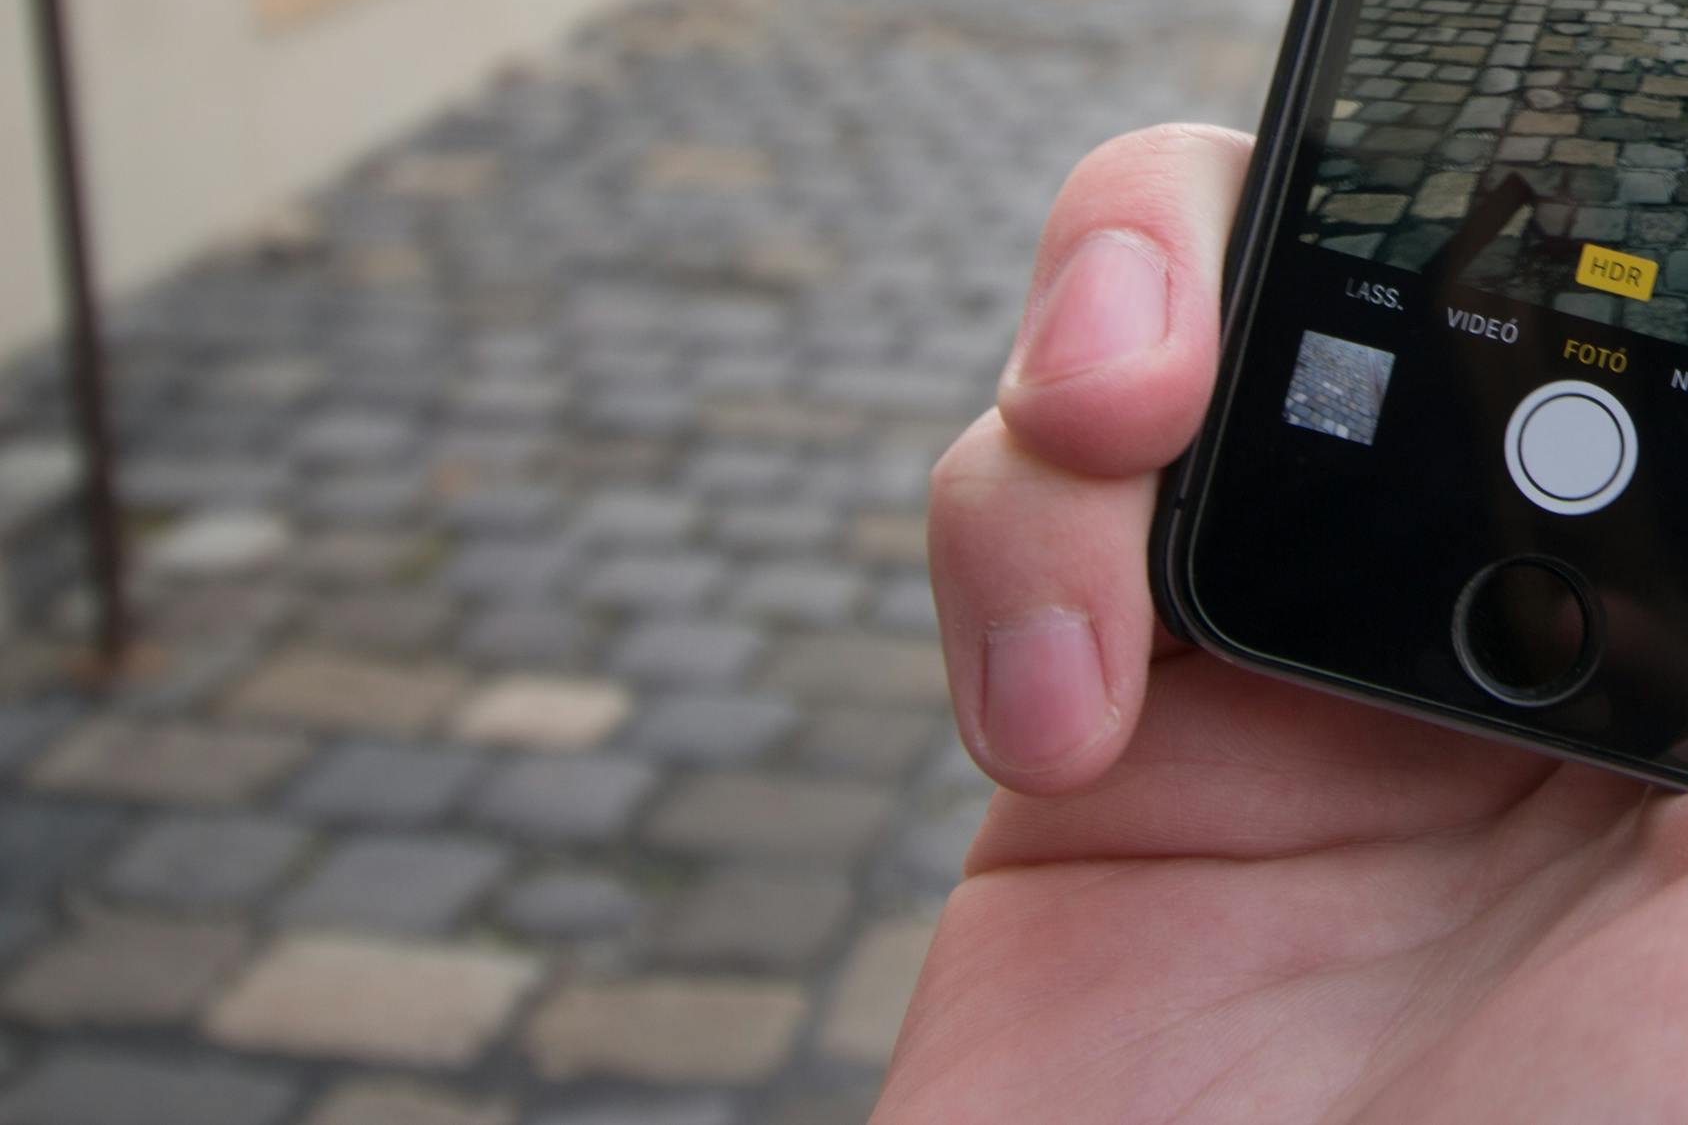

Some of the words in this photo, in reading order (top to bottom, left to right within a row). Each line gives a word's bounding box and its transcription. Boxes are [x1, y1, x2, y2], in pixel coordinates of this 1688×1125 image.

[1589, 256, 1642, 288] HDR
[1345, 277, 1404, 312] LASS.
[1447, 307, 1519, 344] VIDEÓ
[1563, 339, 1627, 374] FOTÓ
